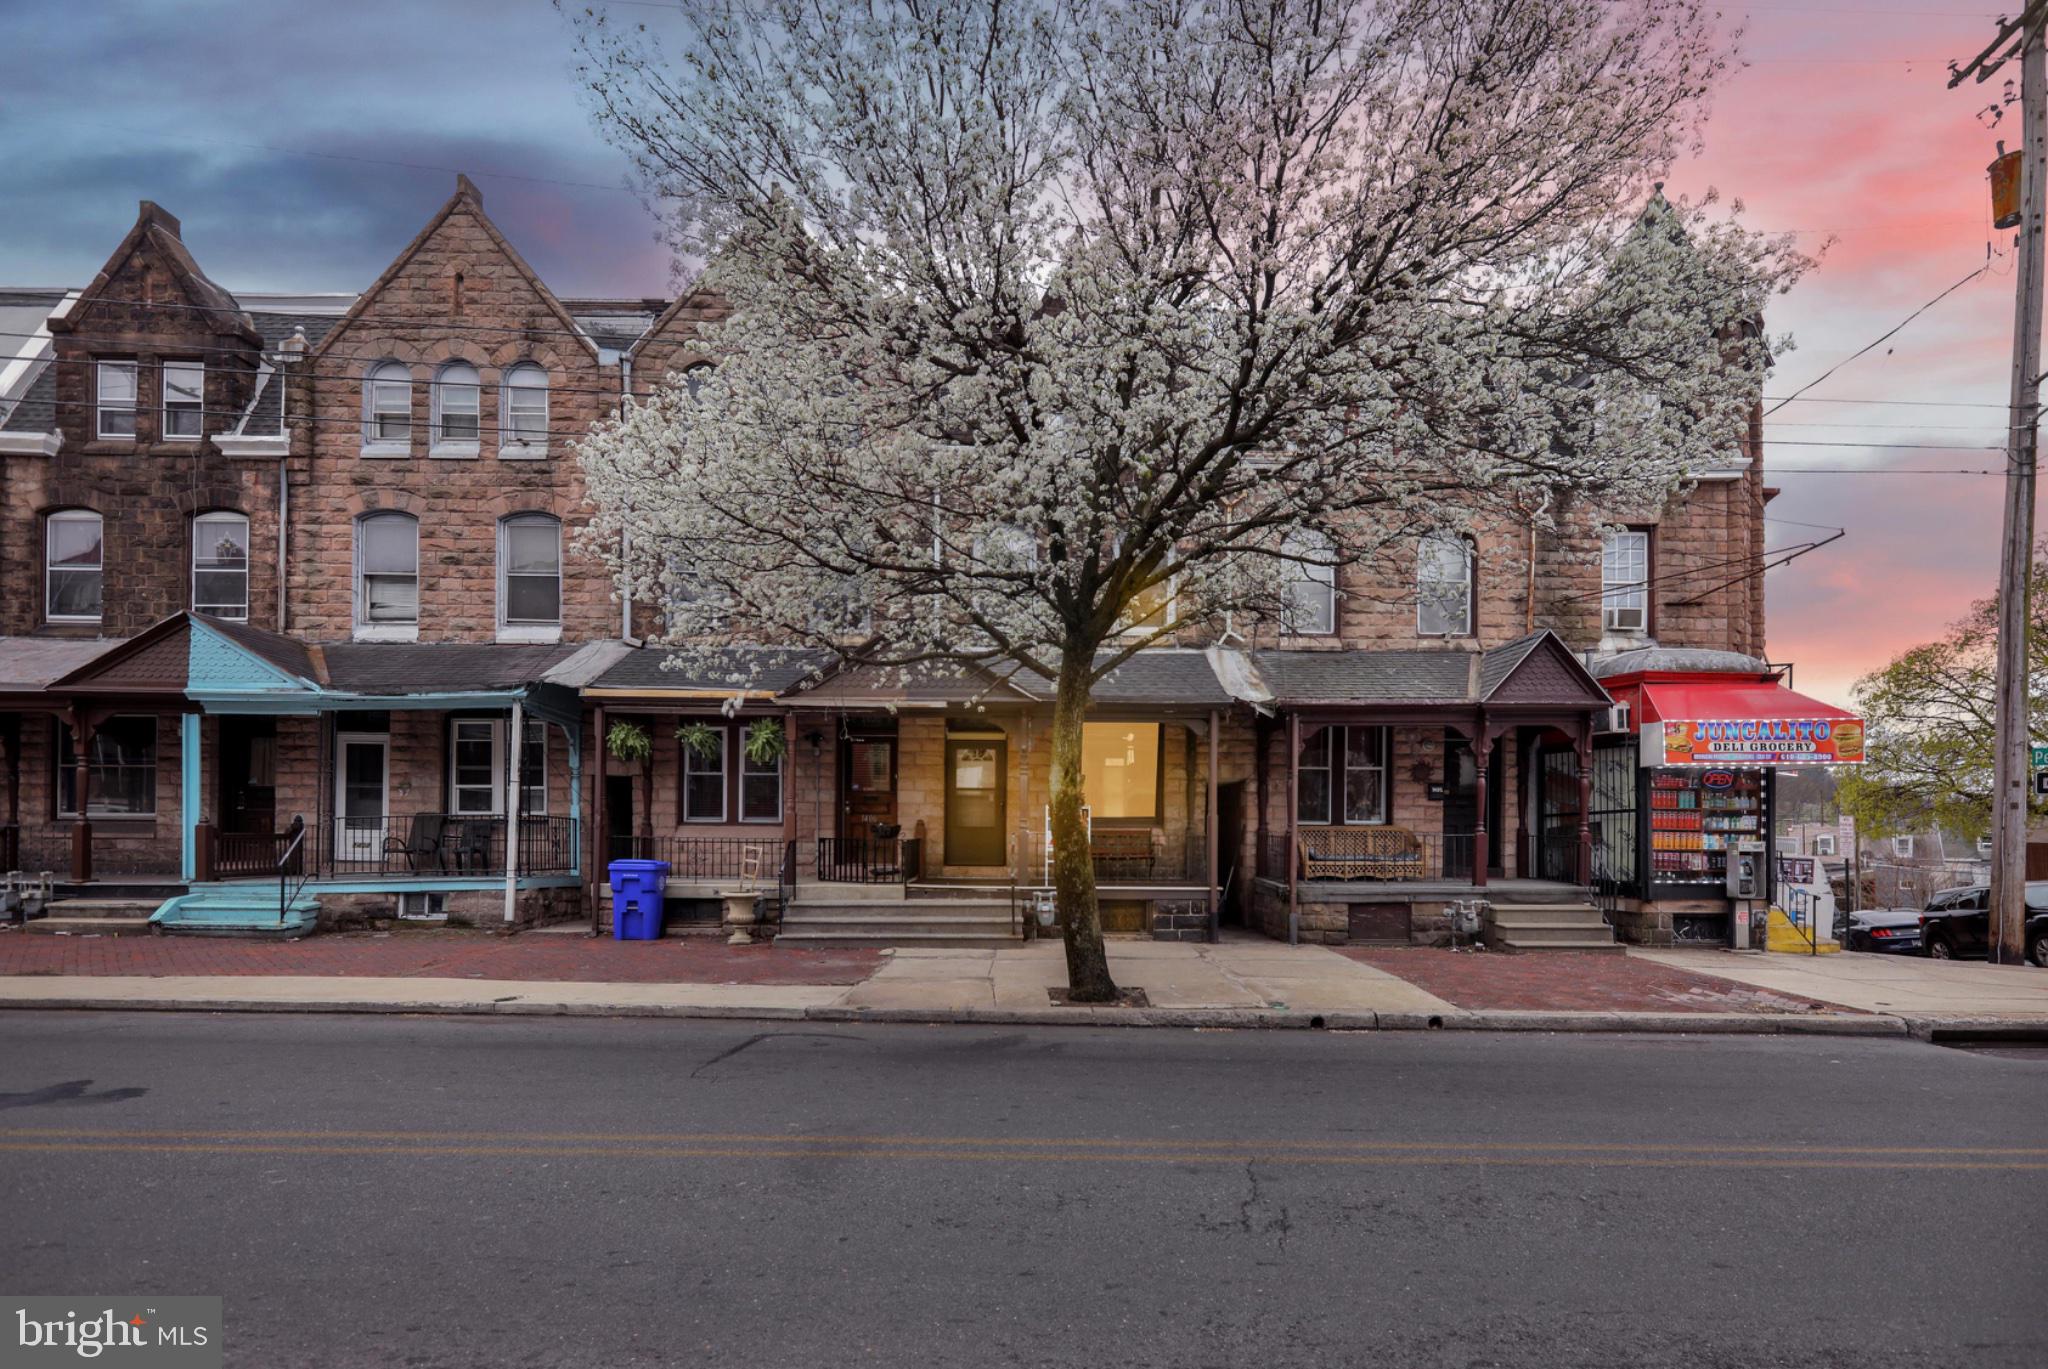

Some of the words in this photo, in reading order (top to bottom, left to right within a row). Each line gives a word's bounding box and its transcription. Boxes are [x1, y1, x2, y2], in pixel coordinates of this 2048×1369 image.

[1694, 721, 1830, 741] JUNCALITO
[1714, 743, 1744, 752] DELI
[1750, 743, 1812, 752] GROCERY
[1703, 773, 1732, 784] OPEN
